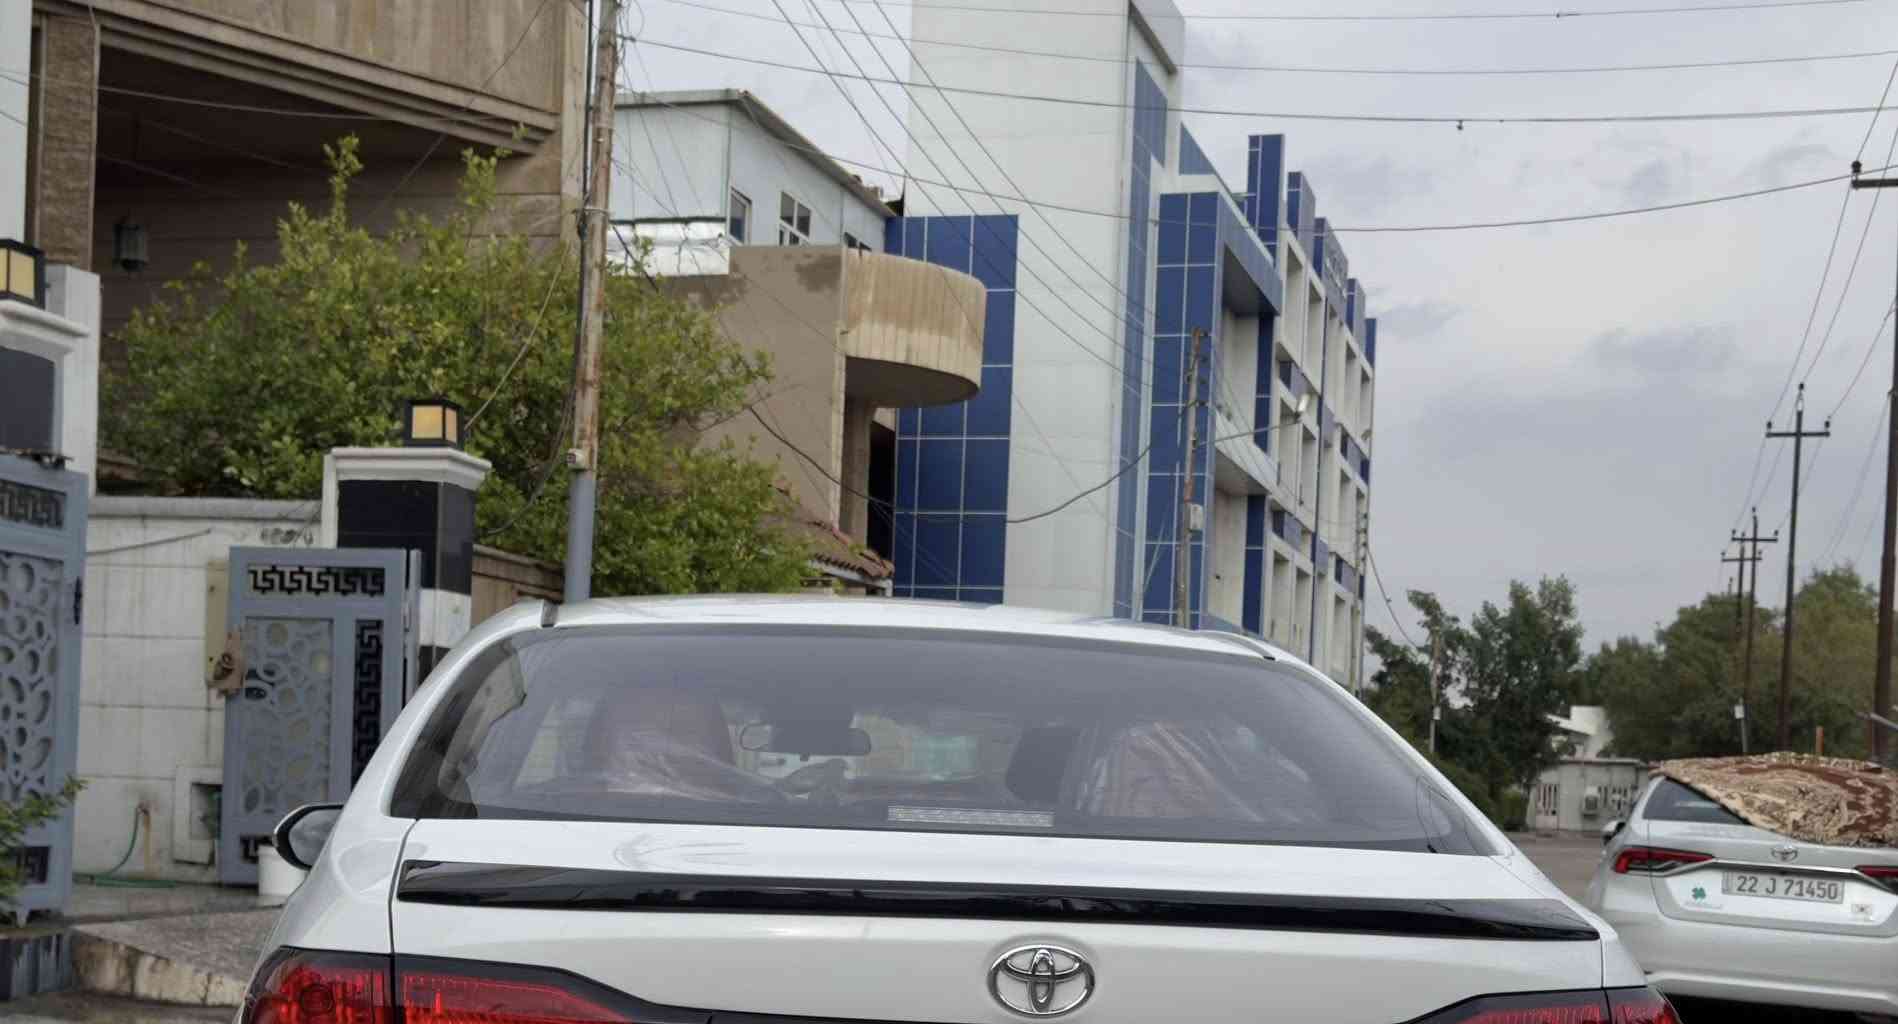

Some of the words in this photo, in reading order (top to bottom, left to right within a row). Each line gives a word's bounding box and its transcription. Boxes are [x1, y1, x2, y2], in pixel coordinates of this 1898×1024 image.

[1736, 875, 1757, 893] 22
[1765, 878, 1776, 894] J
[1783, 879, 1838, 900] 71450
